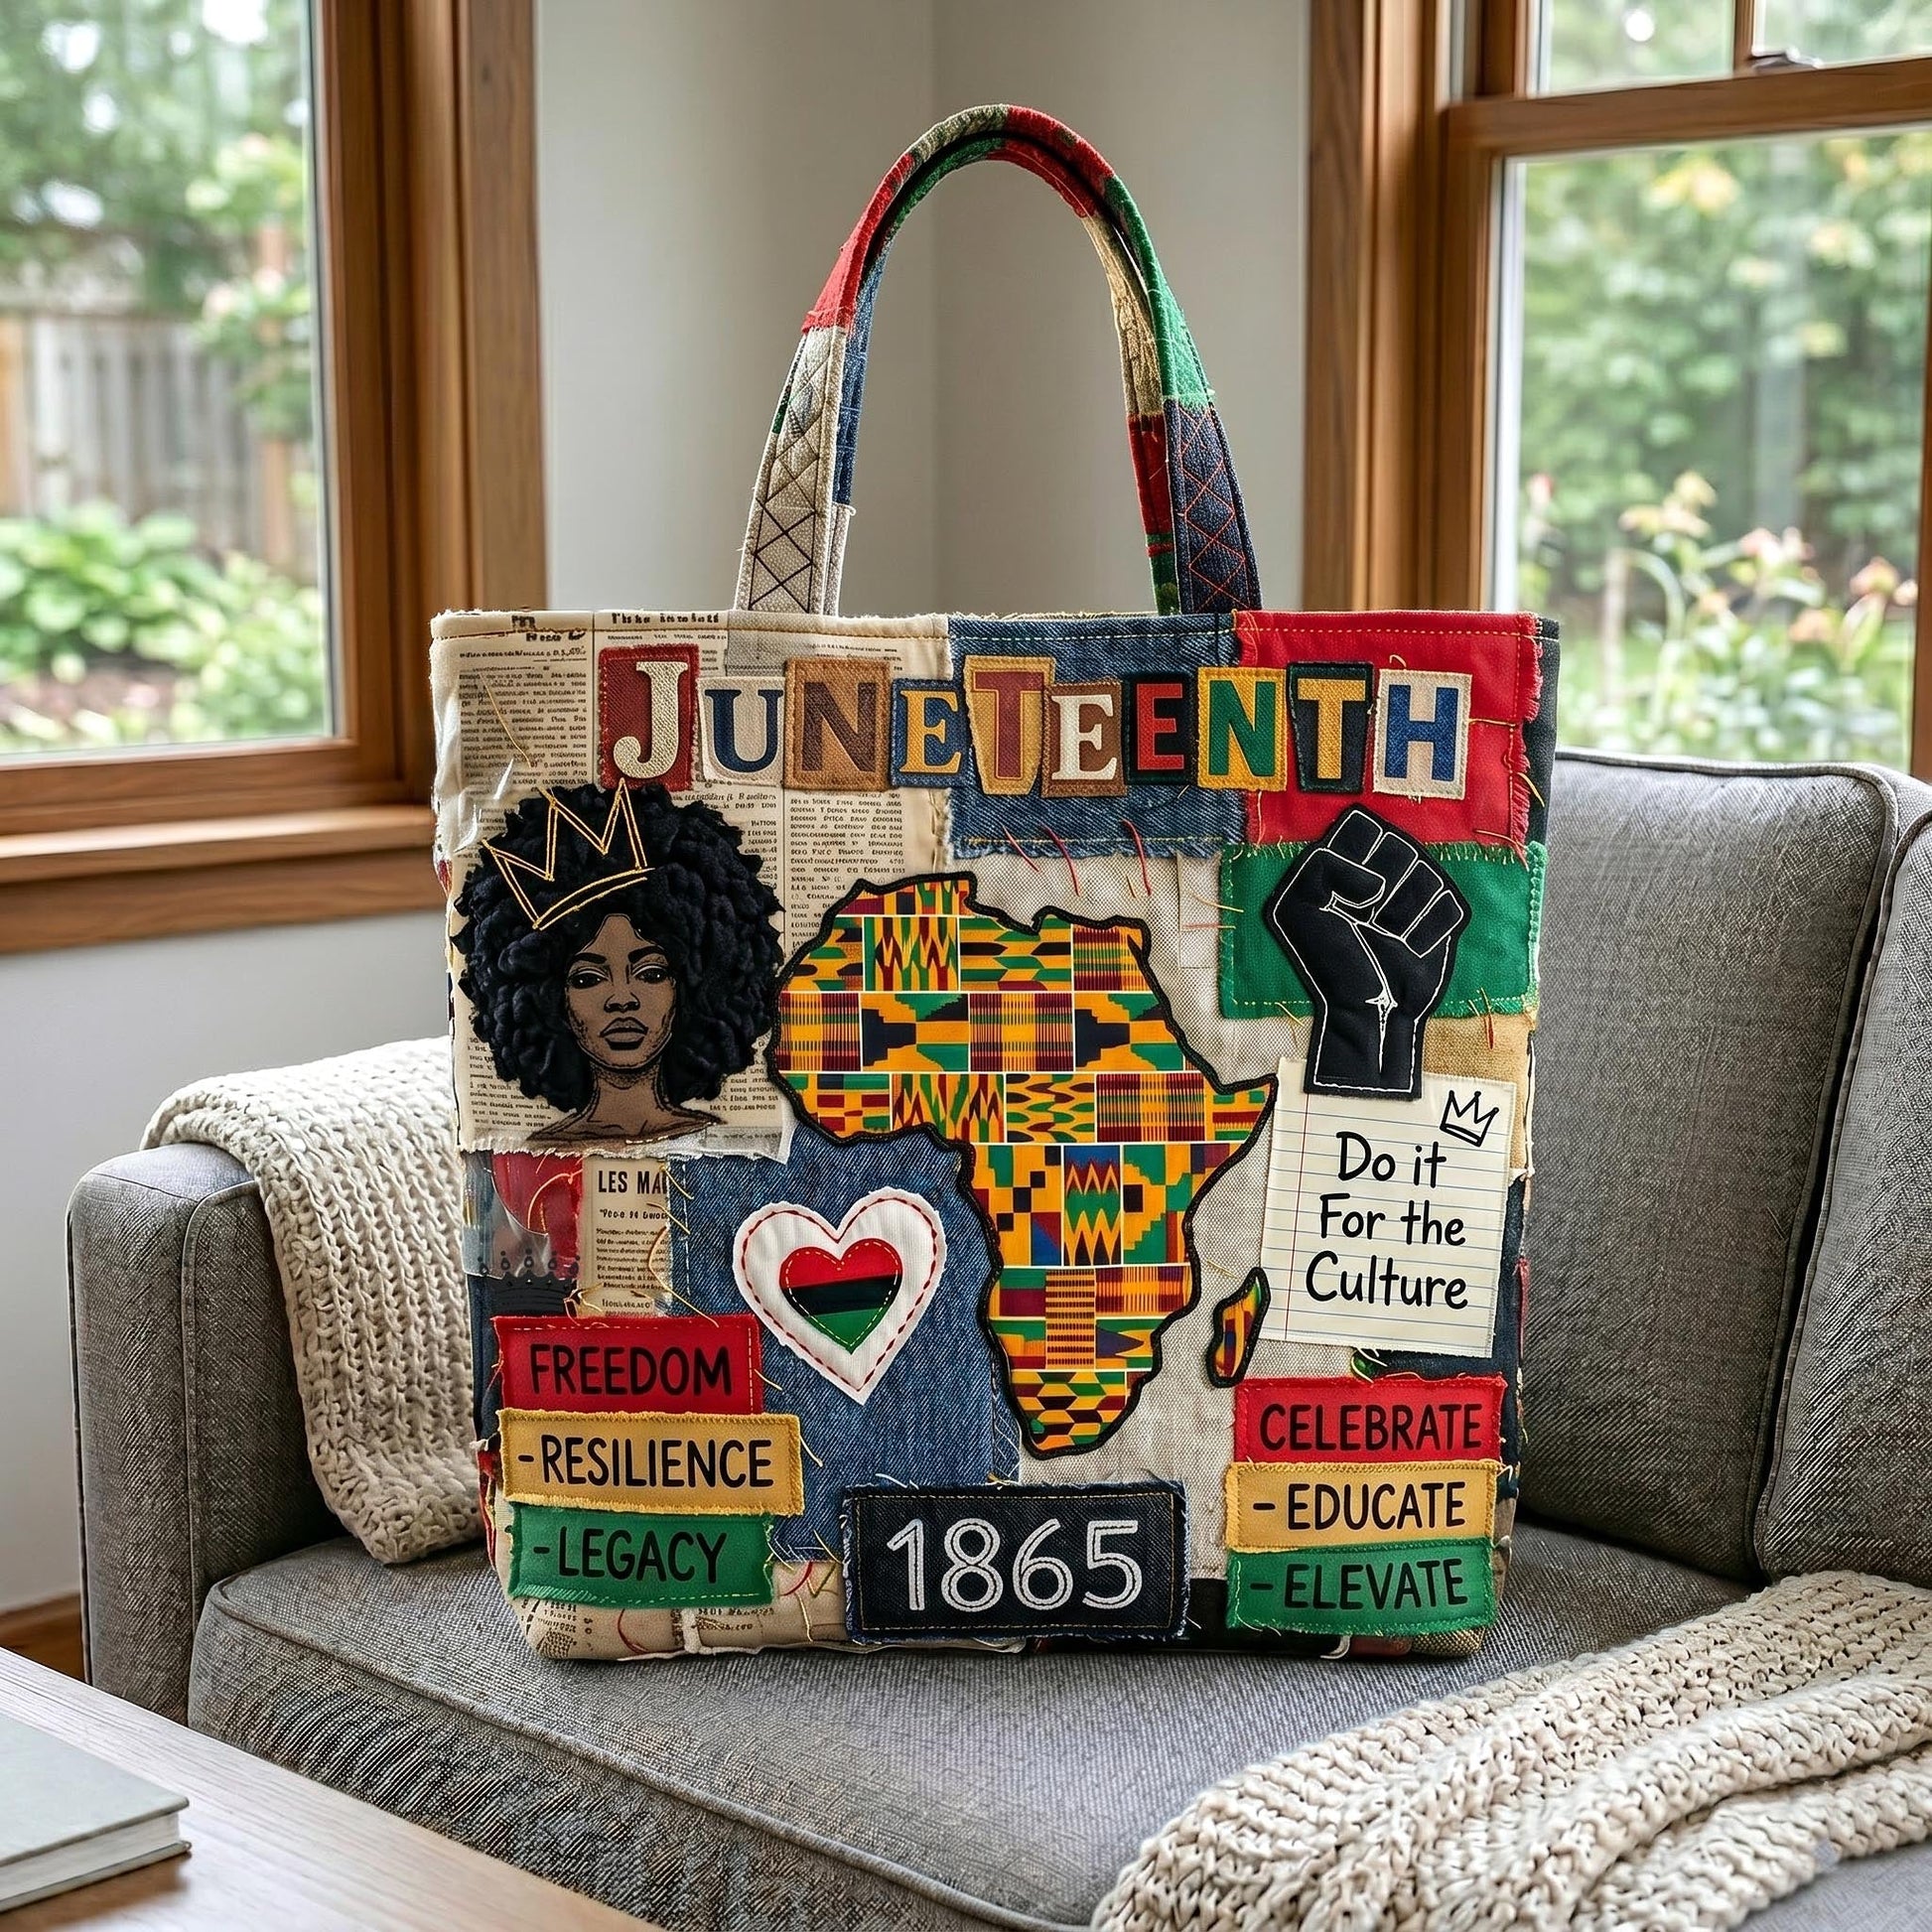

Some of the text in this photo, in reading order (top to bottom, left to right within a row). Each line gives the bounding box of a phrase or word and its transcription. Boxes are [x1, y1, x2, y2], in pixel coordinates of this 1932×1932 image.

[613, 660, 1461, 782] JUNETEENTH
[598, 1171, 627, 1192] LES
[1335, 1131, 1447, 1188] Do it
[1319, 1192, 1465, 1246] For the
[1306, 1250, 1468, 1310] Culture
[529, 1343, 733, 1397] FREEDOM
[1259, 1403, 1483, 1451] CELEBRATE
[887, 1517, 1143, 1612] 1865
